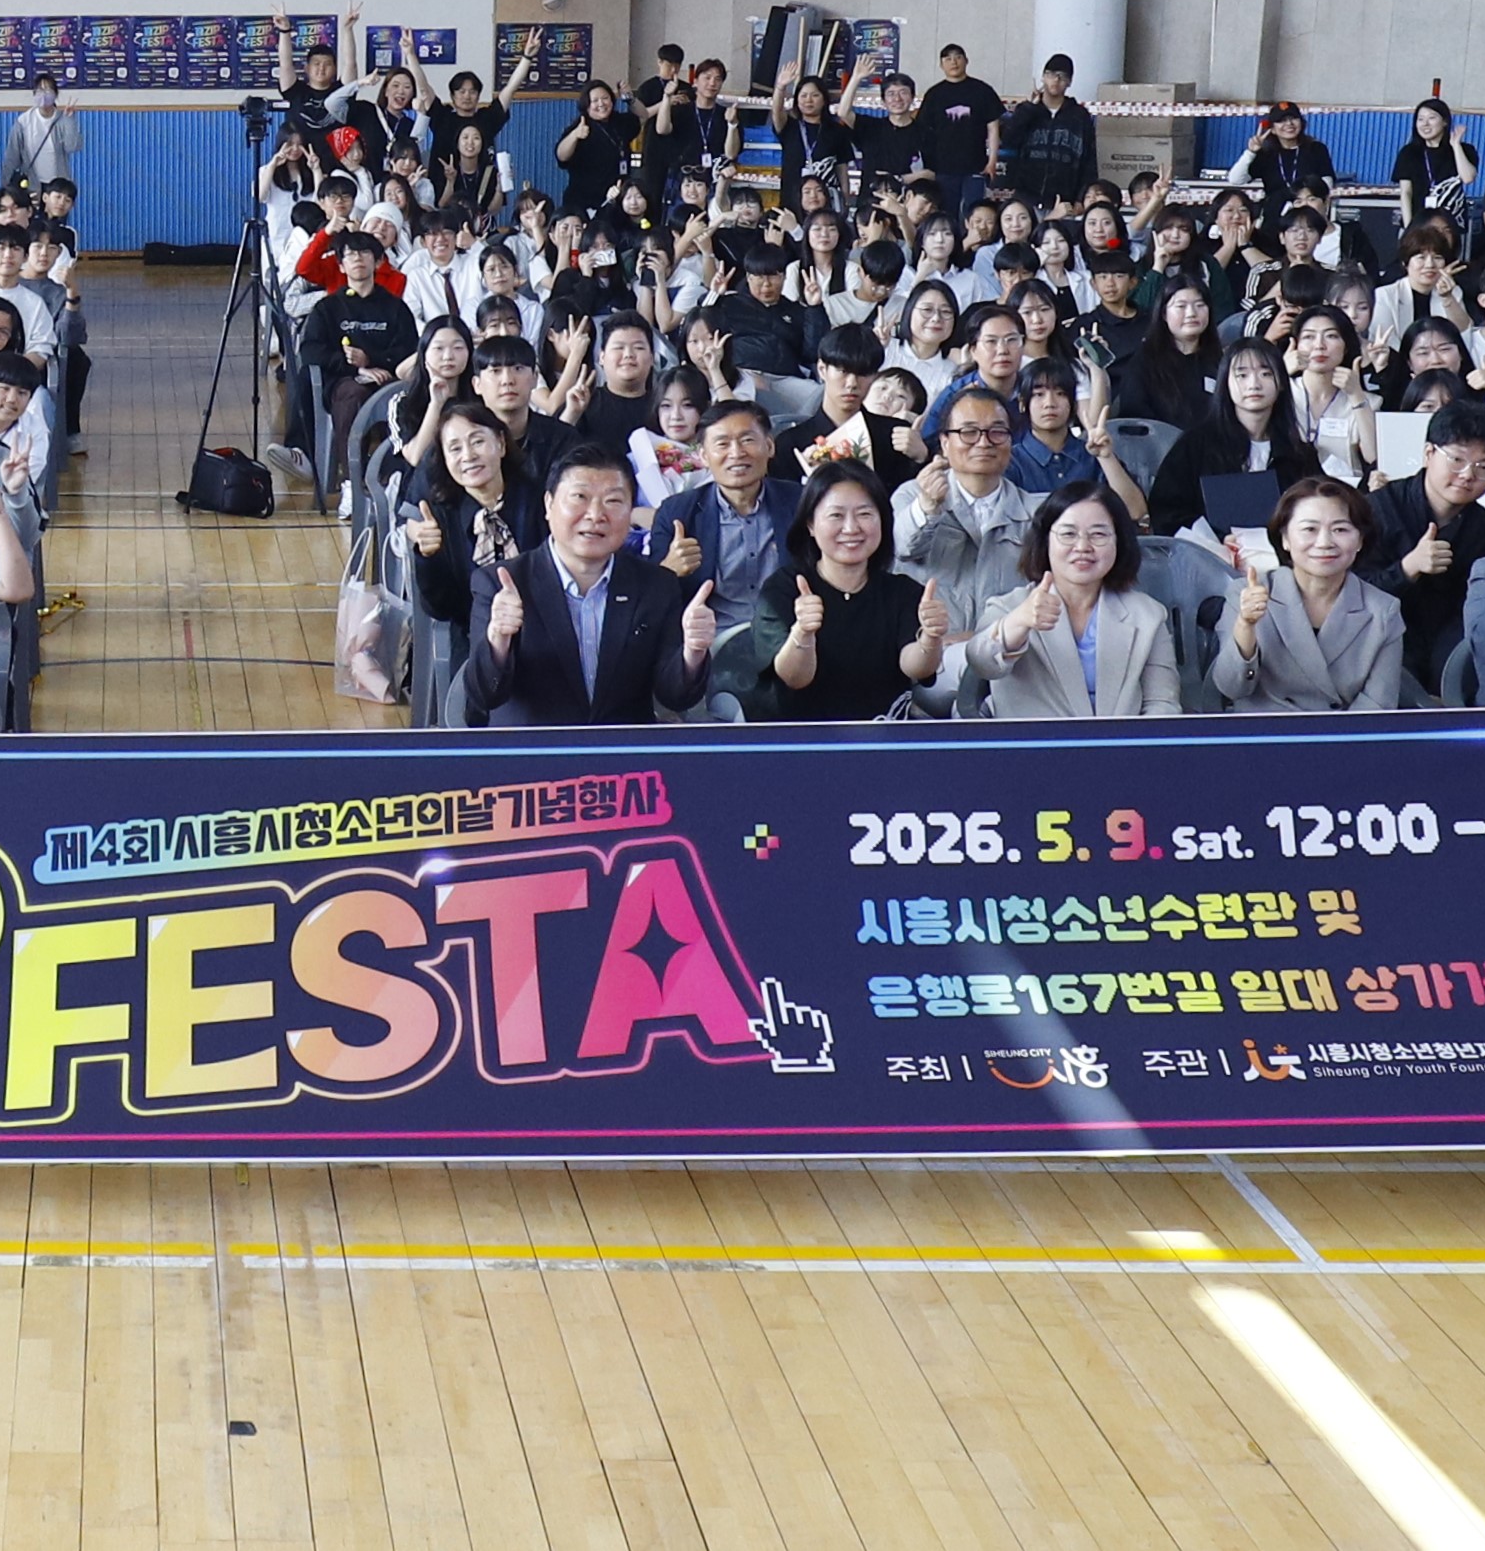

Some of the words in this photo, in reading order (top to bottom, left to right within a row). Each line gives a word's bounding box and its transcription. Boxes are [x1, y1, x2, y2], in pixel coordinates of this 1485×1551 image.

[50, 823, 161, 872] 제4회
[848, 811, 1022, 865] 2026.
[1036, 809, 1091, 862] 5.
[1105, 807, 1164, 861] 9.
[1173, 825, 1254, 861] Sat.
[1266, 803, 1441, 858] 12:00
[856, 889, 1300, 947] 시흥시청소년수련관
[1308, 887, 1364, 937] 및
[3, 857, 756, 1111] FESTA
[865, 970, 1224, 1020] 은행로167번길
[1231, 966, 1340, 1013] 일대
[886, 1054, 953, 1083] 주최
[1142, 1048, 1210, 1078] 주관
[1313, 1064, 1370, 1079] Siheung
[1373, 1063, 1401, 1077] City
[1406, 1061, 1446, 1075] Youth
